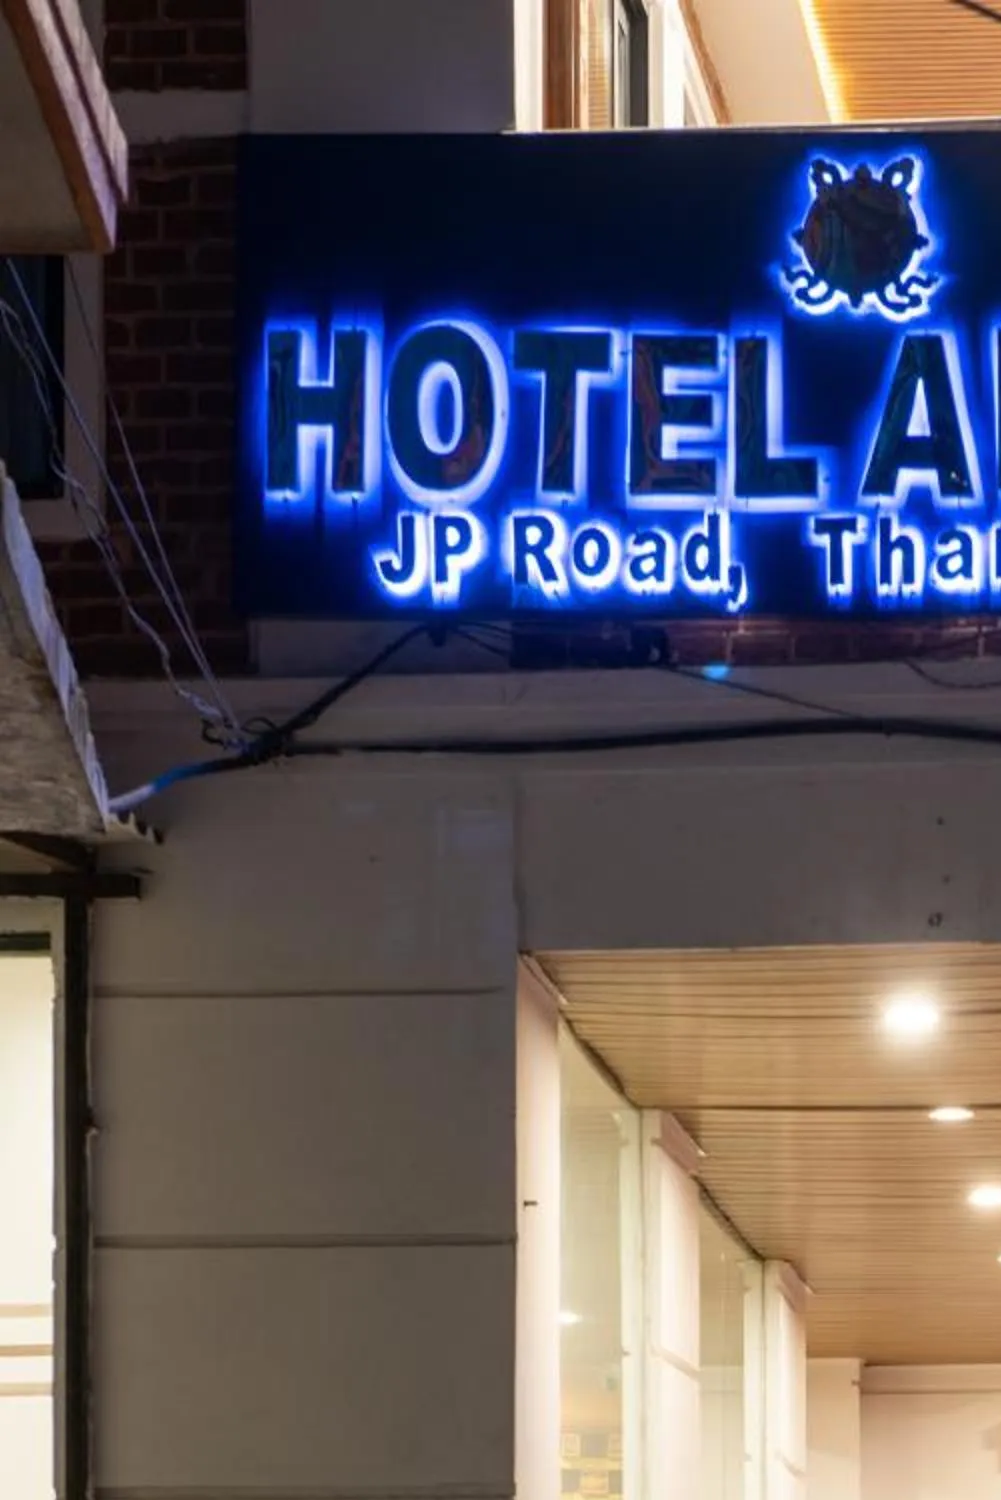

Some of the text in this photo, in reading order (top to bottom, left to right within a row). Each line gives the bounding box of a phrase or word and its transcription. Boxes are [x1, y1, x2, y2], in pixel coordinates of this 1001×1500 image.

[264, 320, 826, 510] HOTEL
[376, 510, 481, 598] JP
[511, 508, 747, 611] Road,
